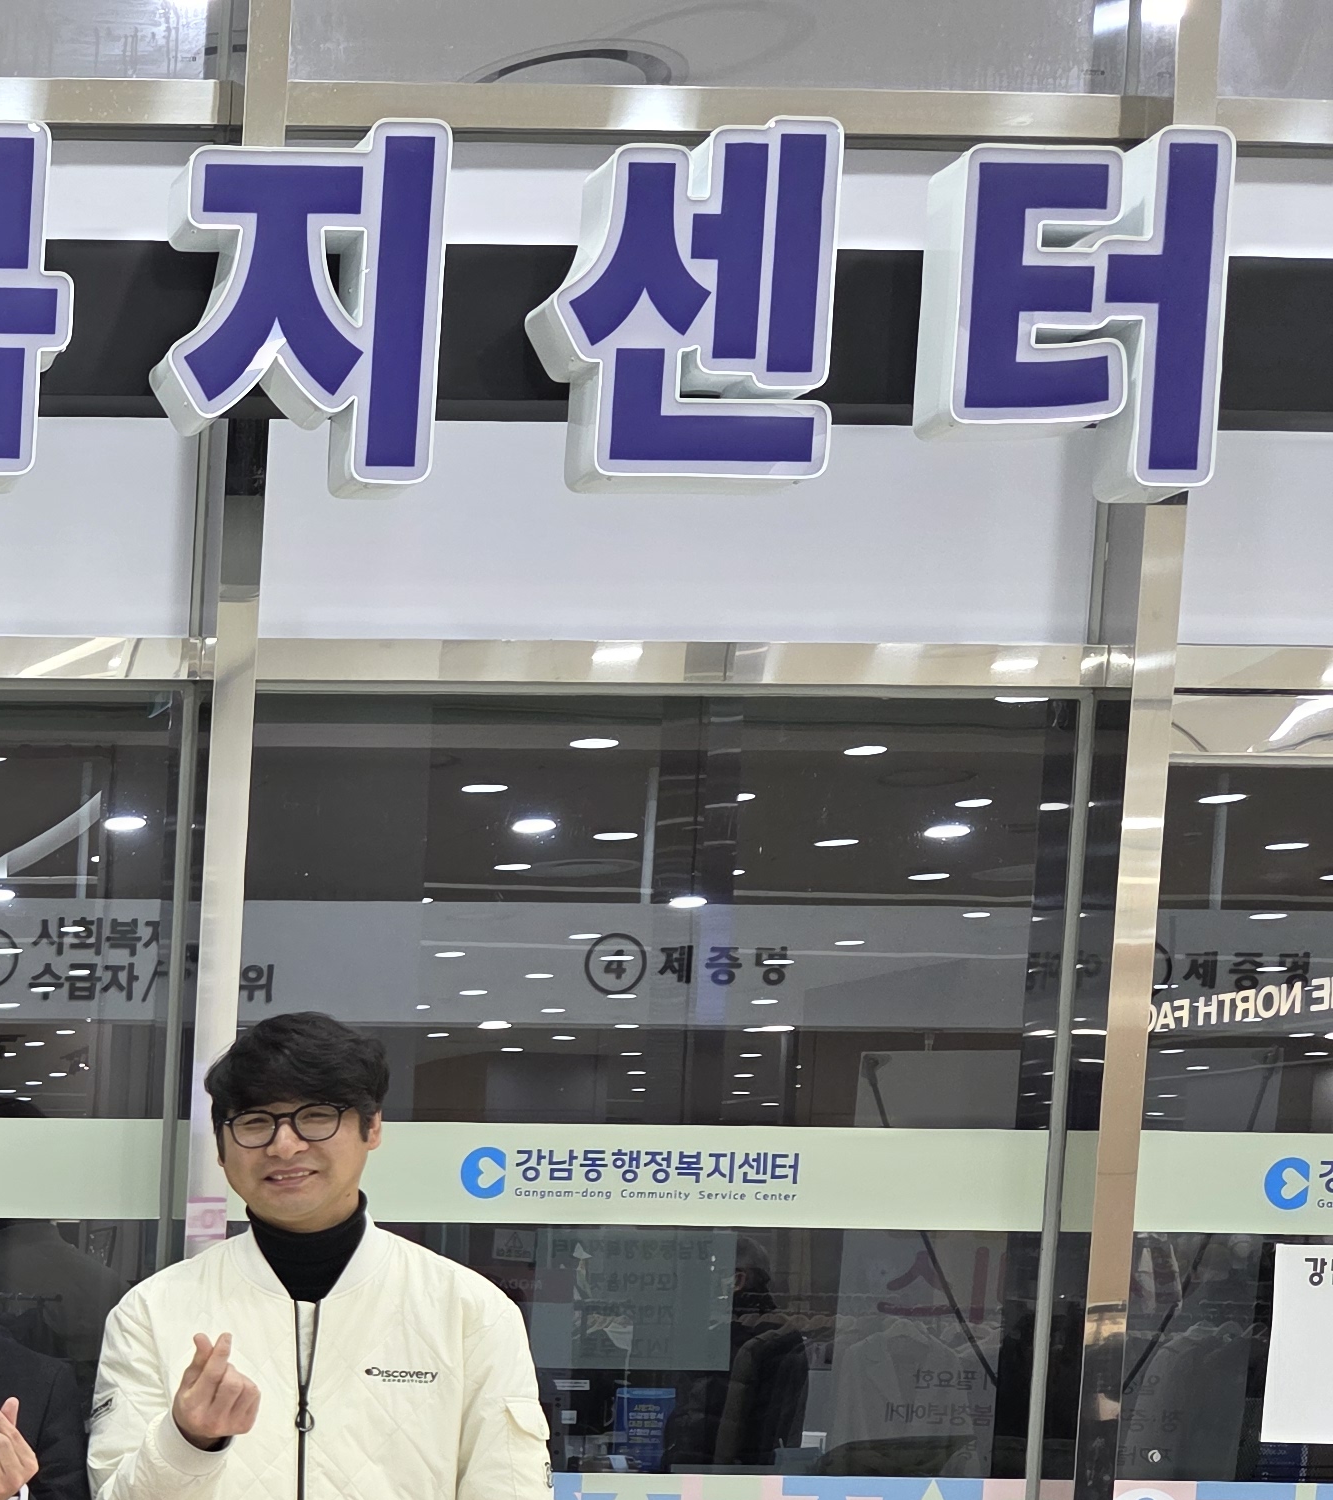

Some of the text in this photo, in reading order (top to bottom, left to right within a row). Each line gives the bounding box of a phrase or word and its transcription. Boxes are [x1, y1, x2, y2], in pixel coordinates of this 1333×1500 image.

[515, 1148, 800, 1185] 강남동행정복지센터
[514, 1187, 797, 1202] Gangnam-dong Community Service Center
[365, 1366, 439, 1383] Discovery
